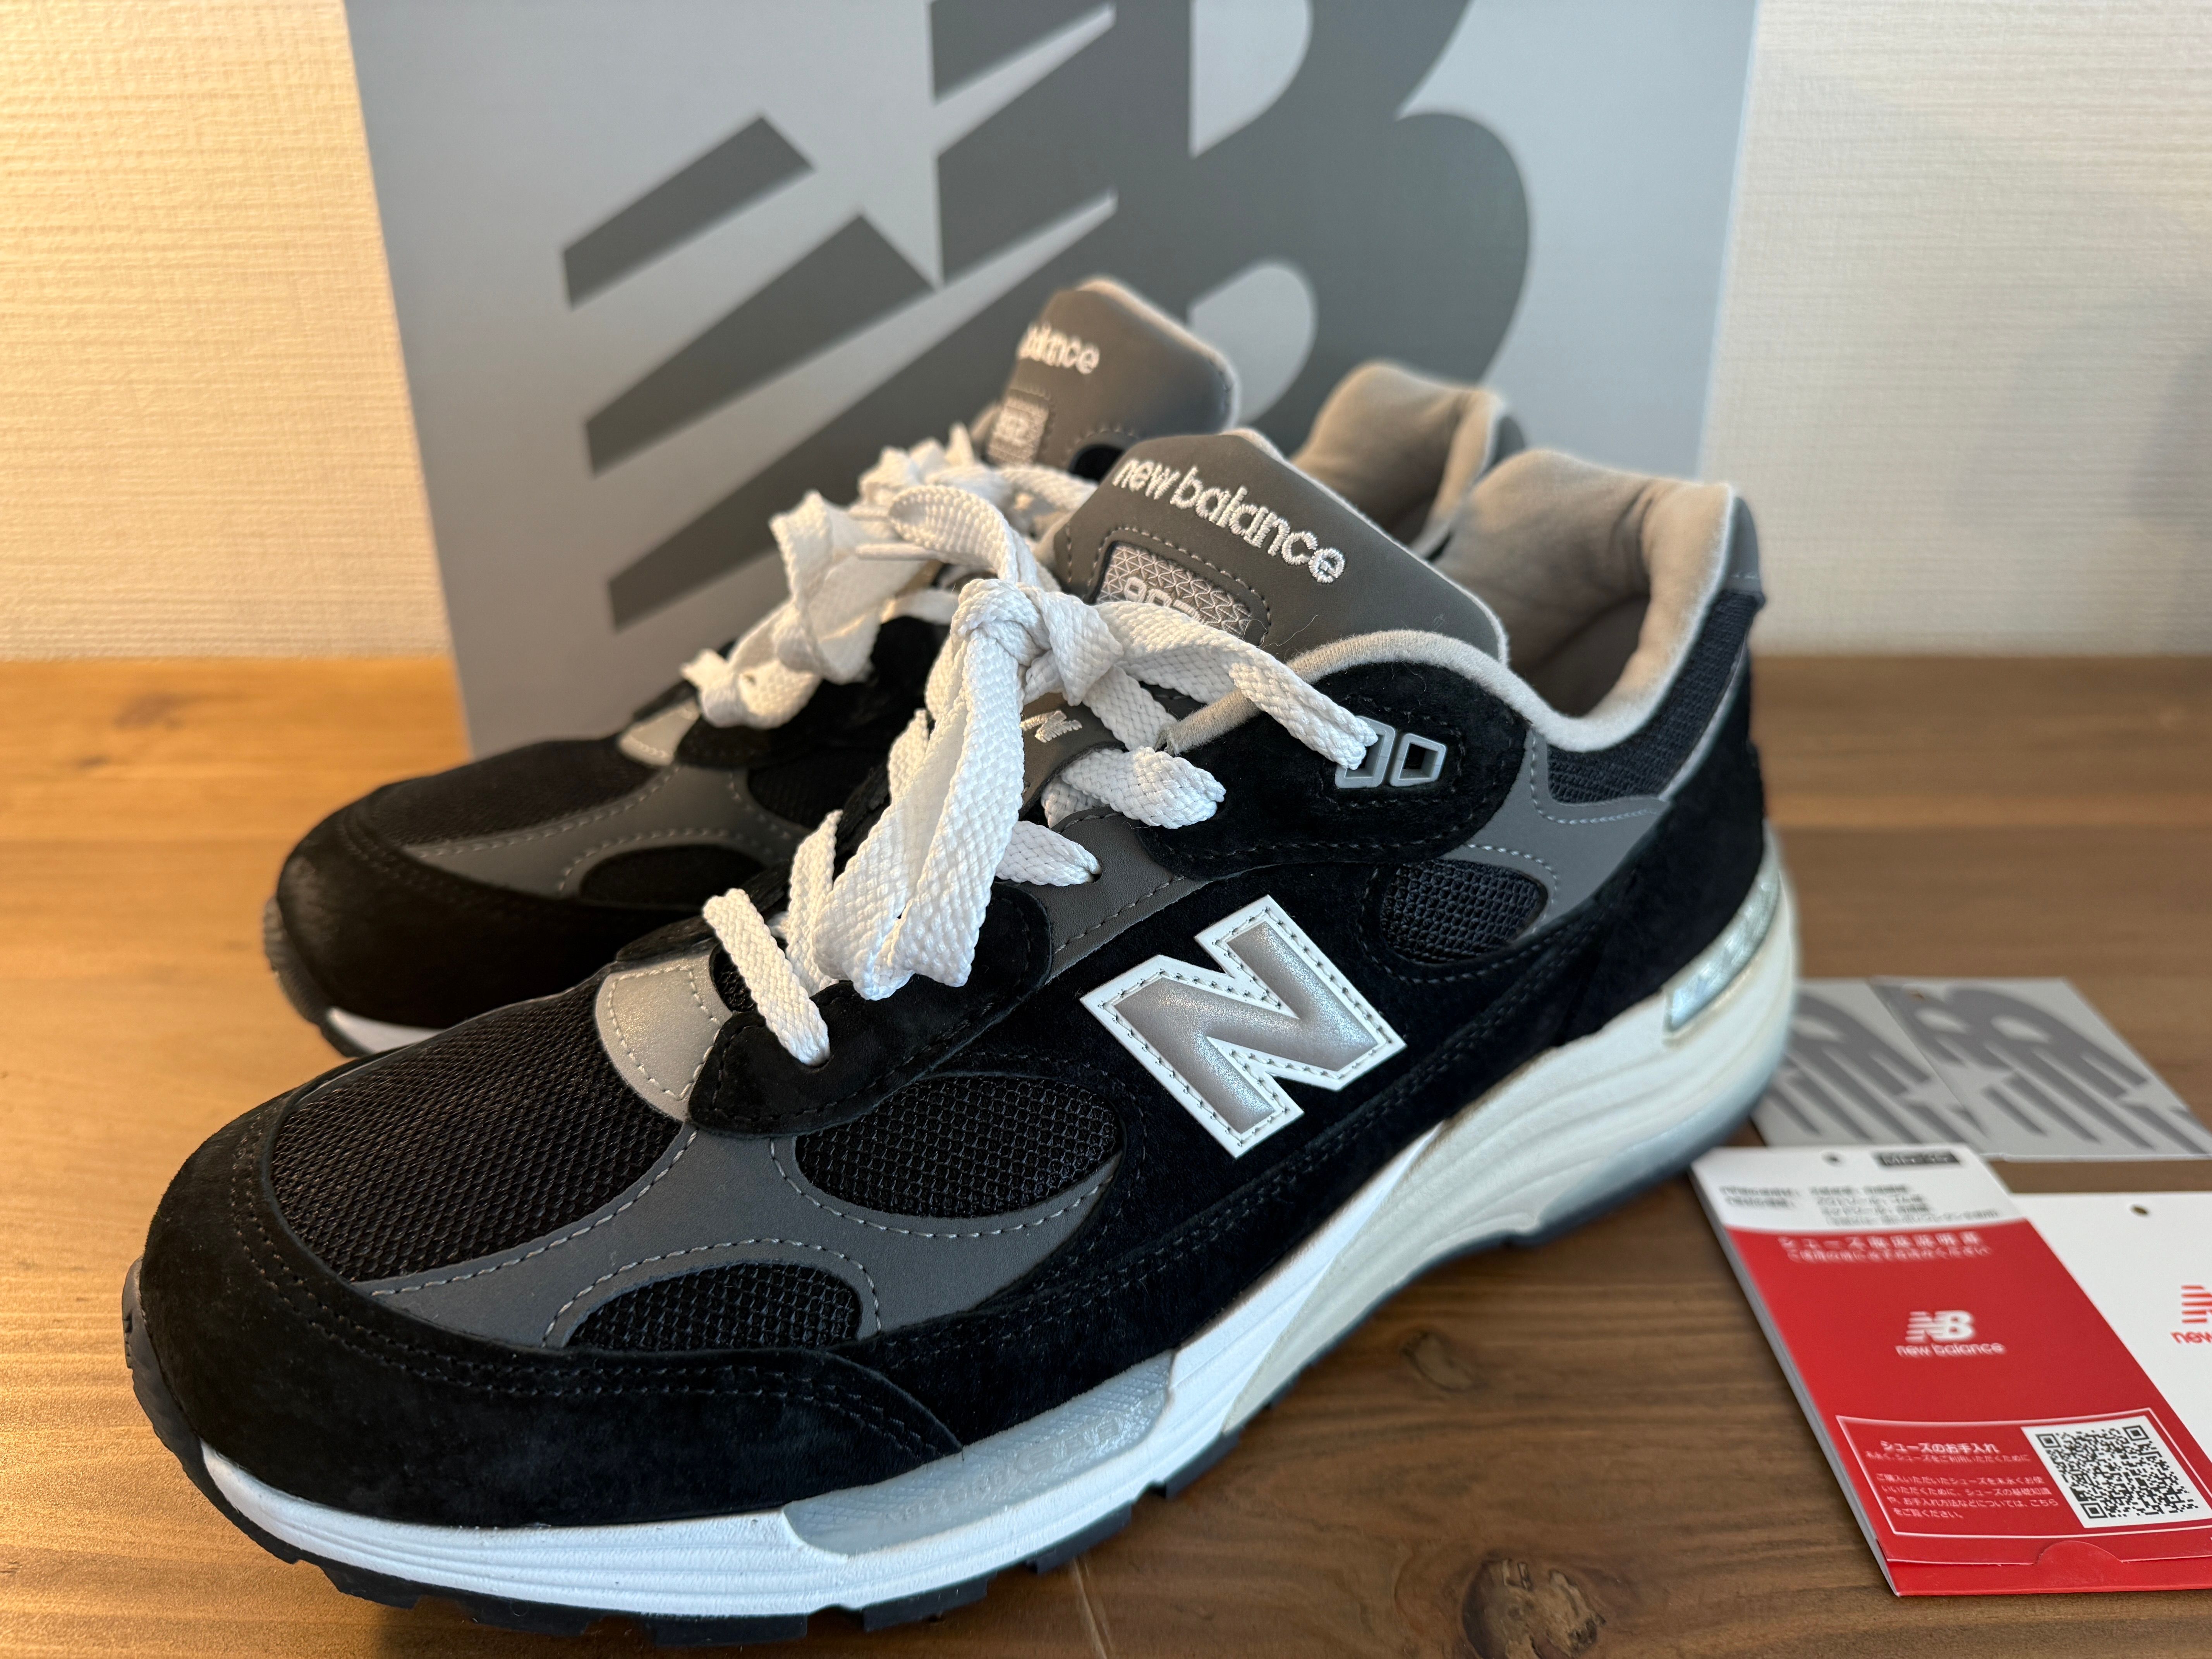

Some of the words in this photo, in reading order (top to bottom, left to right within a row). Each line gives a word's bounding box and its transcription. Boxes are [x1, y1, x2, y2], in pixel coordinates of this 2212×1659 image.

[1112, 458, 1180, 500] new
[1170, 465, 1345, 584] balance
[1080, 894, 1407, 1159] N
[1905, 1310, 1975, 1345] NB
[1894, 1345, 1932, 1358] new
[1931, 1342, 2006, 1356] balance
[1880, 1440, 2000, 1454] シューズのお手入れ
